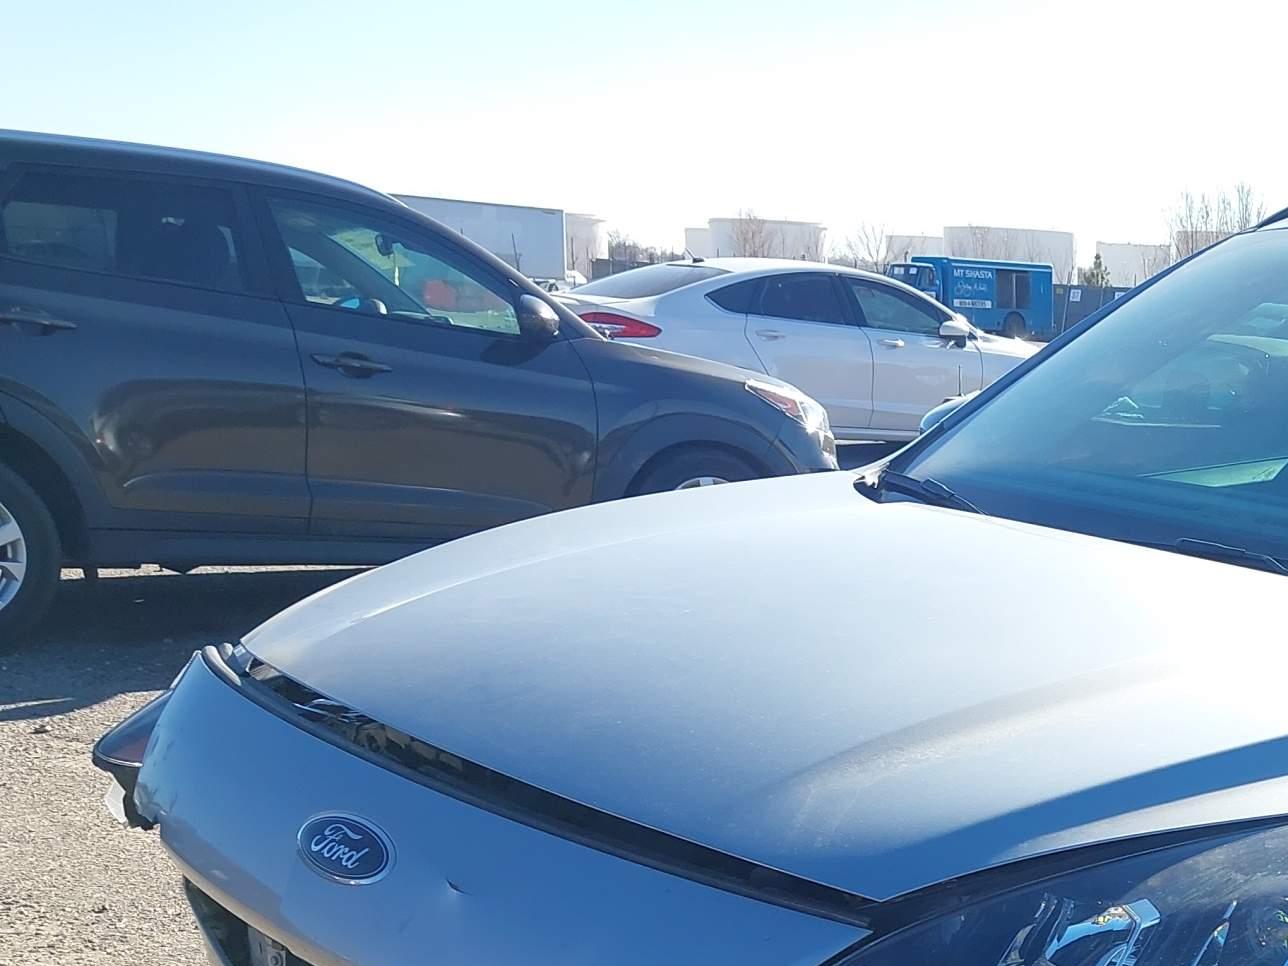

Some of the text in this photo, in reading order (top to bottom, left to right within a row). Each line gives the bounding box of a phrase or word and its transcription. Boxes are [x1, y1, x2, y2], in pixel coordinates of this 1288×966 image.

[953, 269, 993, 279] MT SHASTA
[310, 823, 369, 869] Ford
